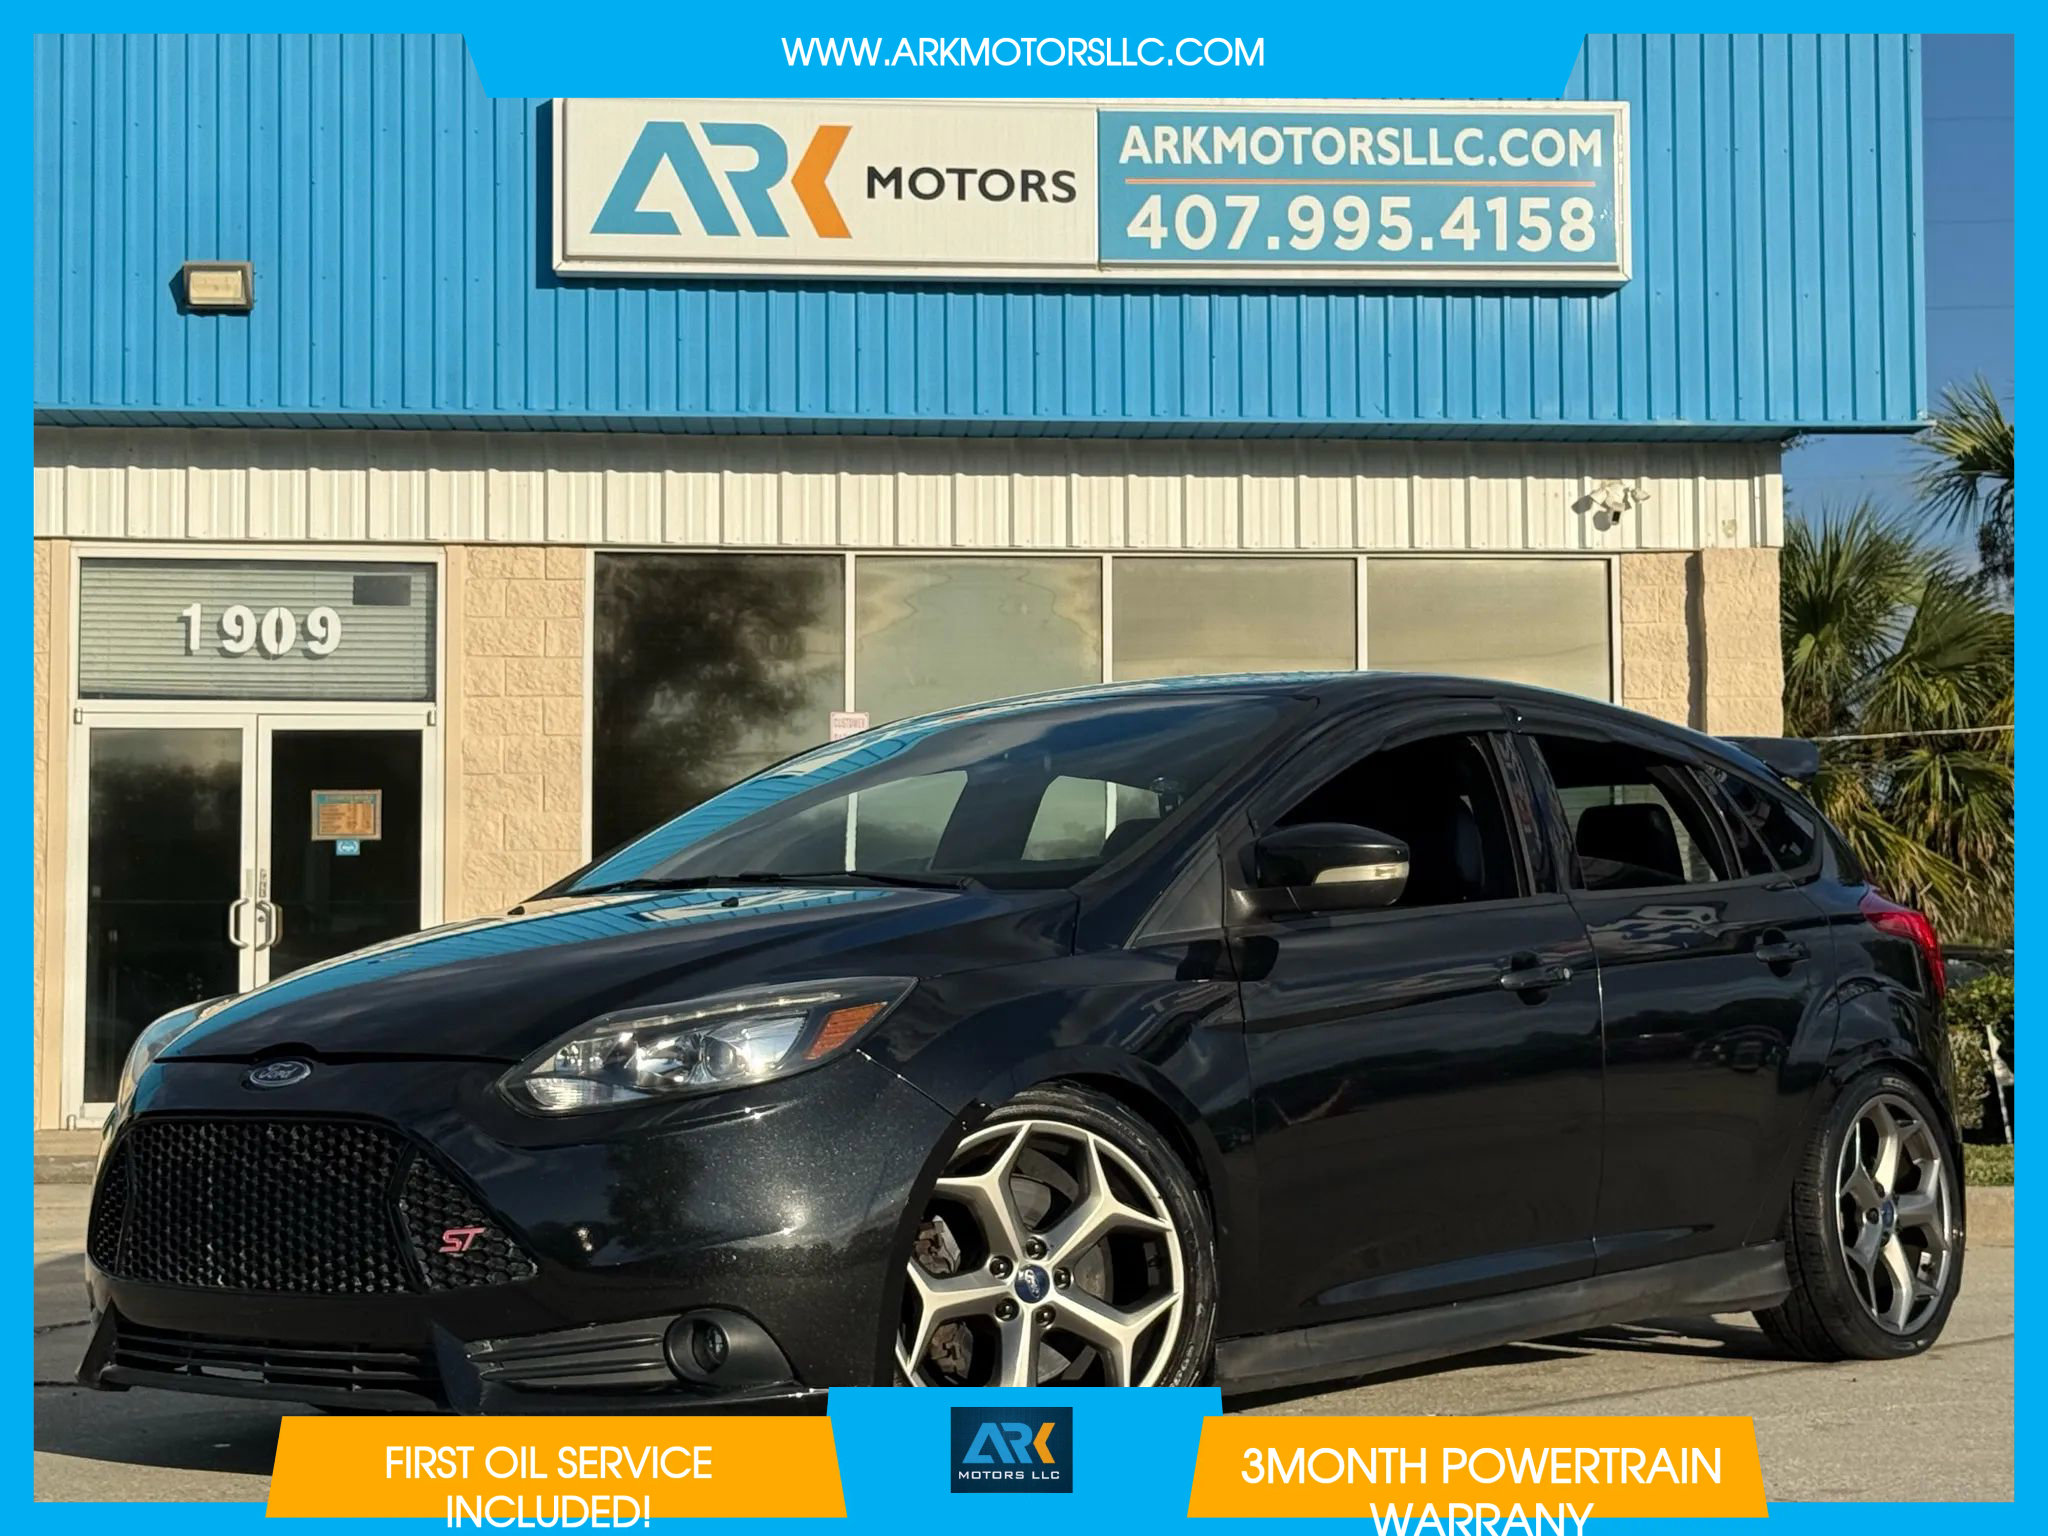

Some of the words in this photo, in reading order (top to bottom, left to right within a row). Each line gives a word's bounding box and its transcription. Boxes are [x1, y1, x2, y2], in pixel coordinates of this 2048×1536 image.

[1119, 125, 1602, 168] ARKMOTORSLLC.COM
[590, 121, 853, 239] ARK
[866, 165, 1077, 203] MOTORS
[1126, 194, 1597, 253] 407.995.4158
[182, 602, 342, 655] 1909
[438, 1227, 487, 1252] ST
